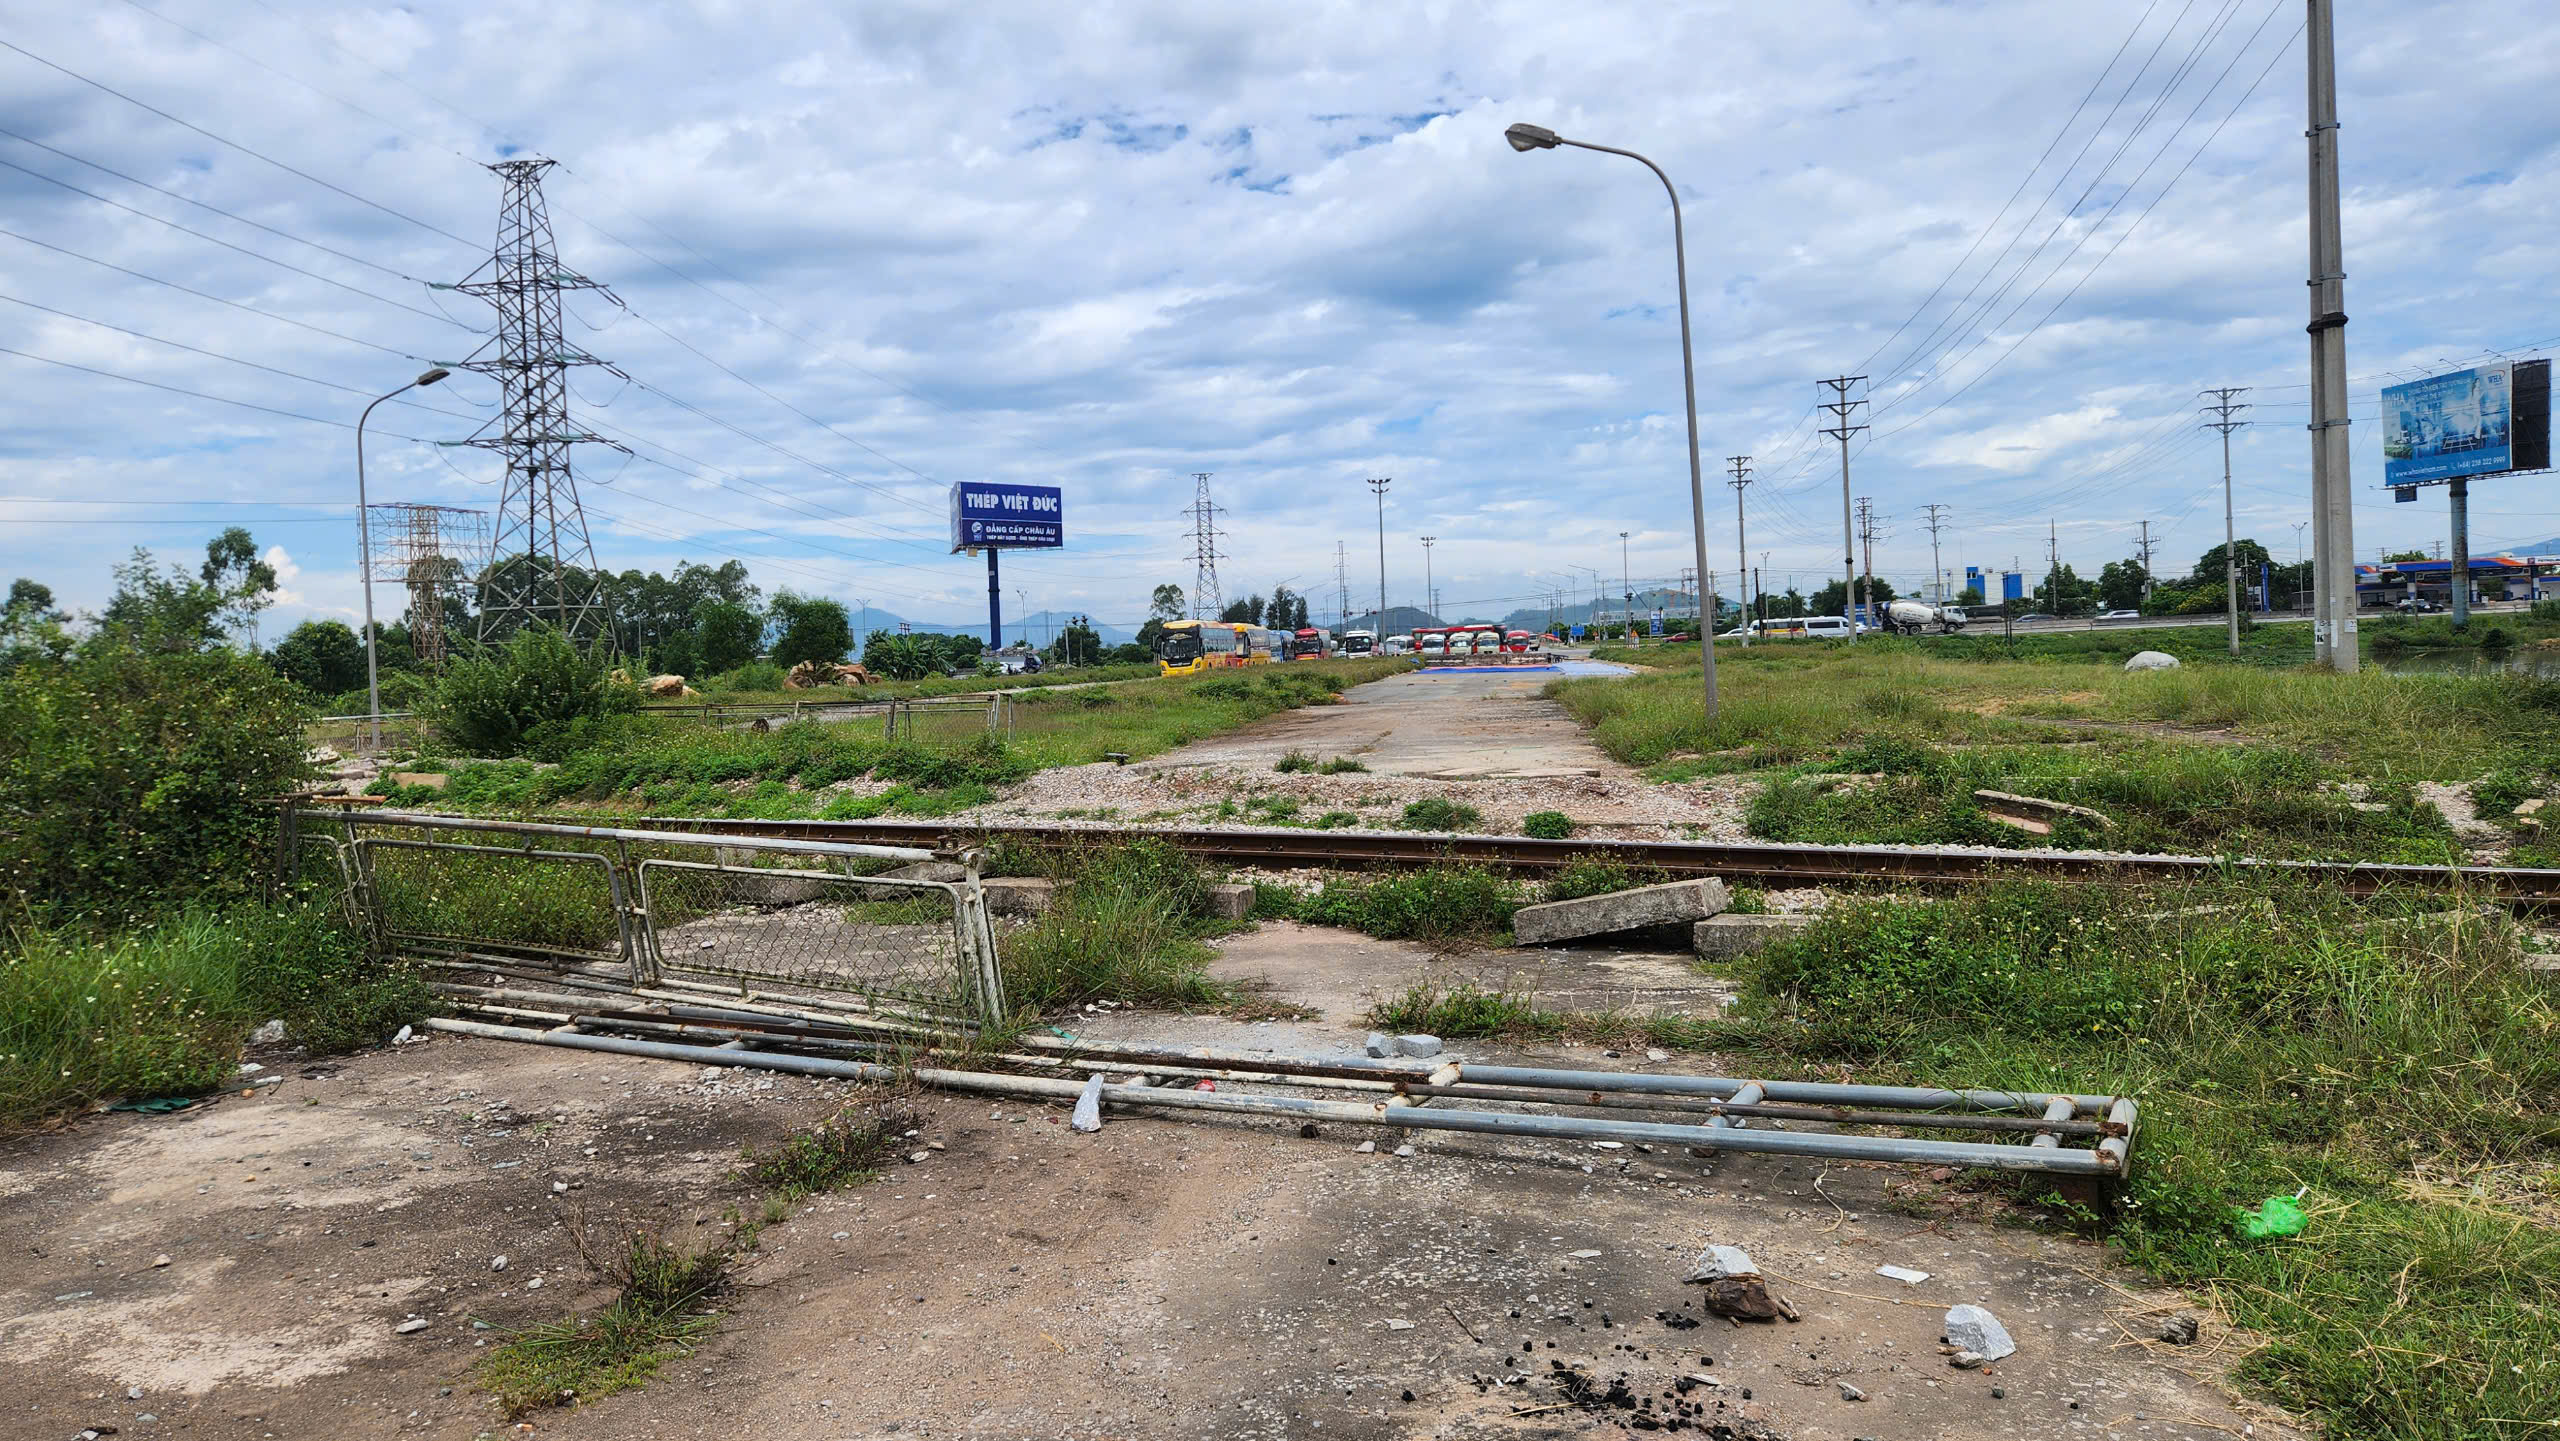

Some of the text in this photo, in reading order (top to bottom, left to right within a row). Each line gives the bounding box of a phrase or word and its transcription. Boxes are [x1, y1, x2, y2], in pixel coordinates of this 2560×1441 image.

[966, 491, 1058, 513] THÉP VIỆT ĐỨC
[1008, 524, 1024, 534] CẤP
[1024, 525, 1044, 535] CHÂU
